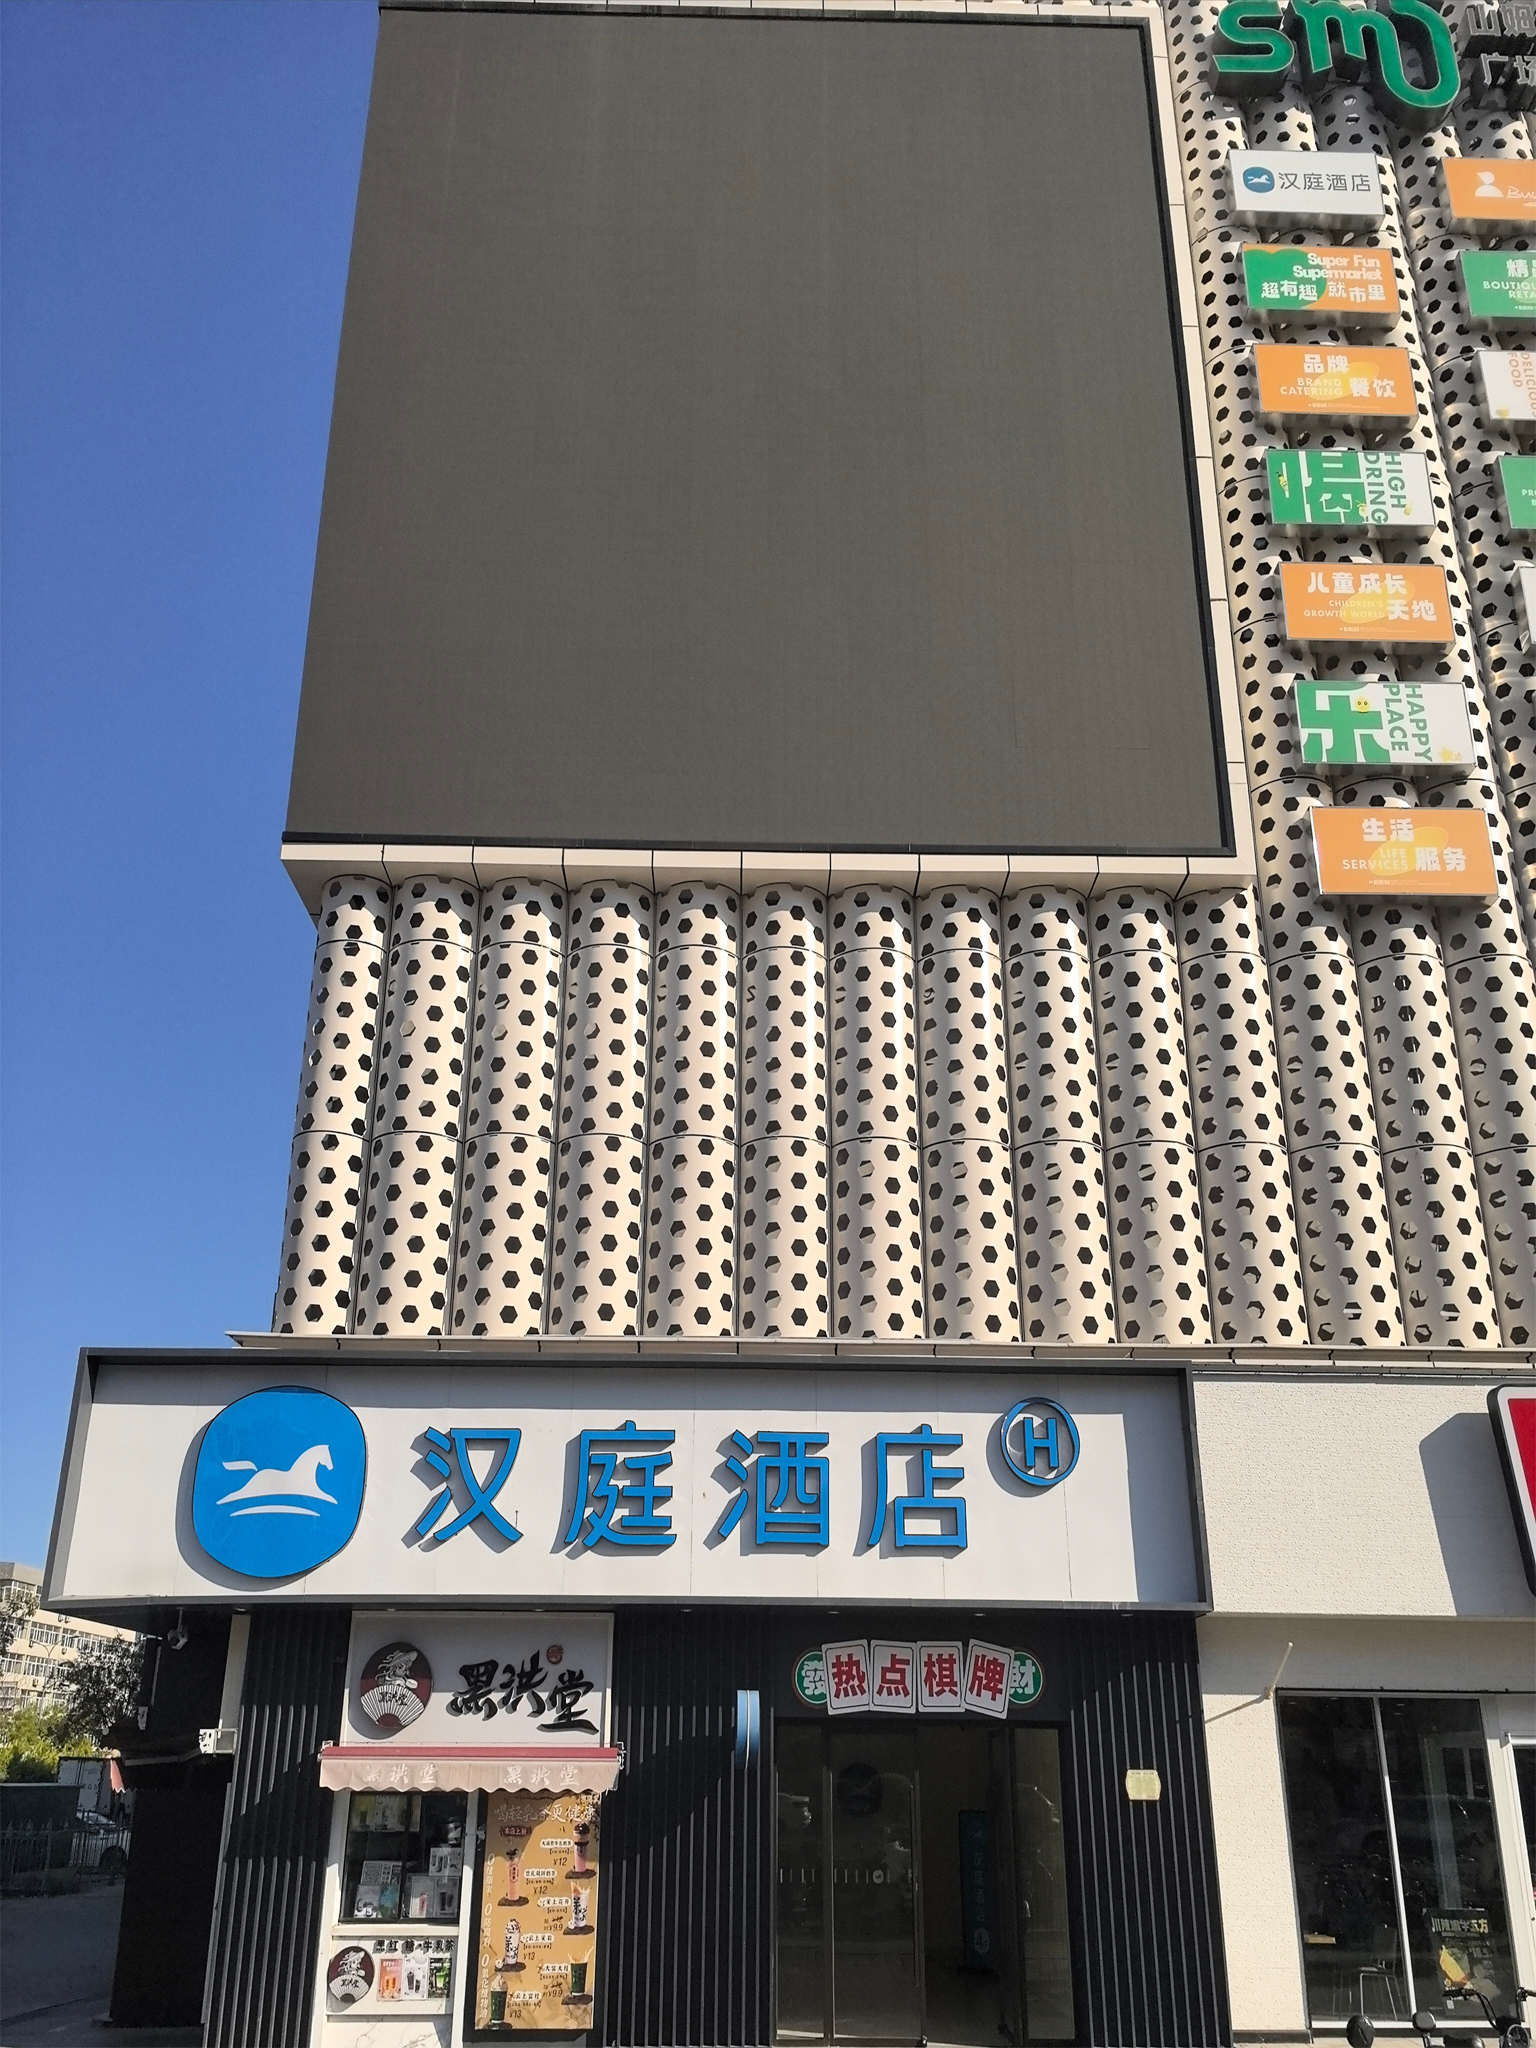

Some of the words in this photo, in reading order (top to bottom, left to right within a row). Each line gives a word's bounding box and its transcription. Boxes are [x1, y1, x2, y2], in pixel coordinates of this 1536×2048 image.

[1278, 172, 1371, 192] 汉庭酒店
[1307, 253, 1350, 268] Super
[1353, 255, 1380, 267] Fun
[1507, 259, 1536, 277] 精
[1293, 265, 1382, 280] Supermarket
[1261, 280, 1318, 300] 超有趣
[1327, 281, 1386, 302] 就市里
[1303, 354, 1349, 374] 品牌
[1508, 352, 1523, 387] FOOD
[1280, 386, 1343, 396] CATERING
[1297, 377, 1342, 387] BRAND
[1350, 378, 1396, 398] 餐饮
[1364, 453, 1389, 524] DRING
[1384, 453, 1407, 508] HIGH
[1308, 572, 1406, 595] 儿童成长
[1304, 609, 1347, 617] GROWTH
[1350, 610, 1385, 618] WORLD
[1387, 599, 1437, 621] 天地
[1383, 684, 1409, 751] PLACE
[1405, 684, 1433, 762] HAPPY
[1362, 818, 1414, 842] 生活
[1342, 859, 1409, 870] SERVICES
[1379, 849, 1406, 858] LIFE
[1415, 847, 1466, 871] 服务
[415, 1420, 968, 1549] 汉庭酒店
[831, 1653, 1006, 1701] 热点棋牌
